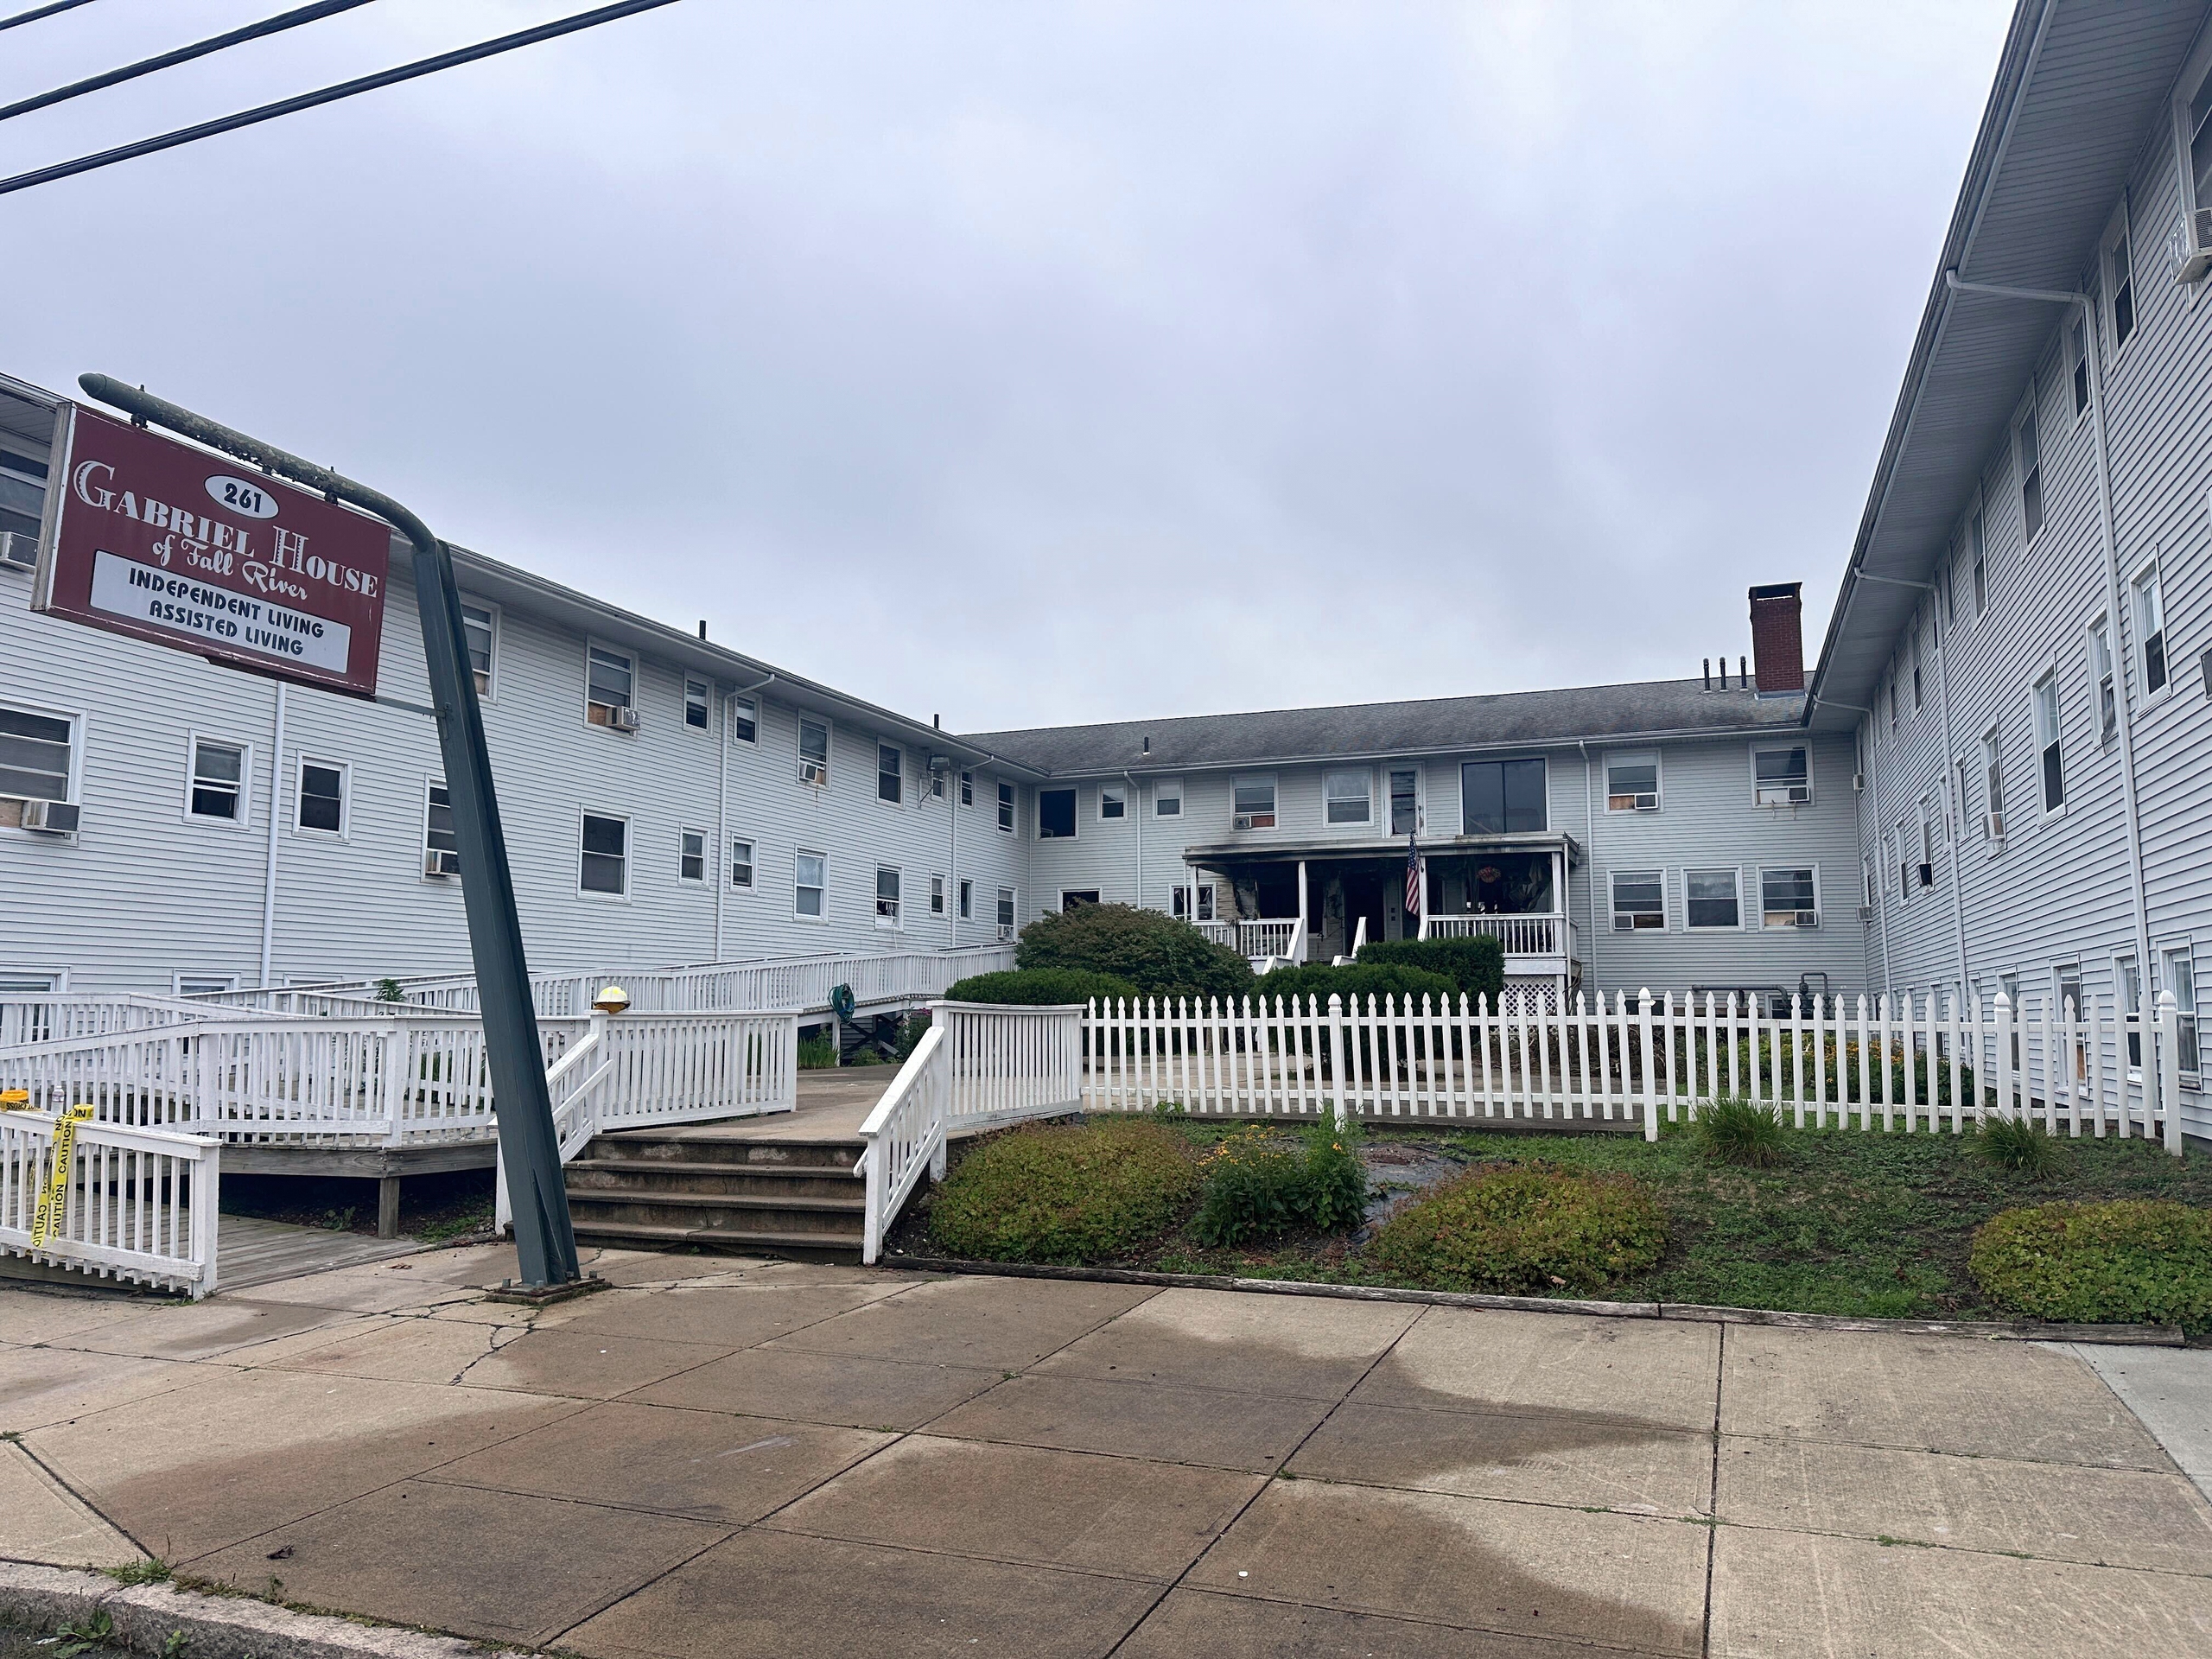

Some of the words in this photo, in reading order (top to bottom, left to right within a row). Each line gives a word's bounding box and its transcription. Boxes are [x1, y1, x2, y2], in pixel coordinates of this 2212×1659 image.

[224, 482, 262, 513] 261
[73, 460, 255, 558] GABRIEL
[269, 525, 378, 598] HOUSE
[152, 534, 175, 567] of
[181, 537, 233, 576] Fall
[242, 561, 308, 601] River
[129, 567, 261, 620] INDEPENDENT
[268, 608, 324, 638] LIVING
[149, 600, 238, 638] ASSISTED
[245, 626, 303, 655] LIVING
[59, 1121, 73, 1173] CAUTION
